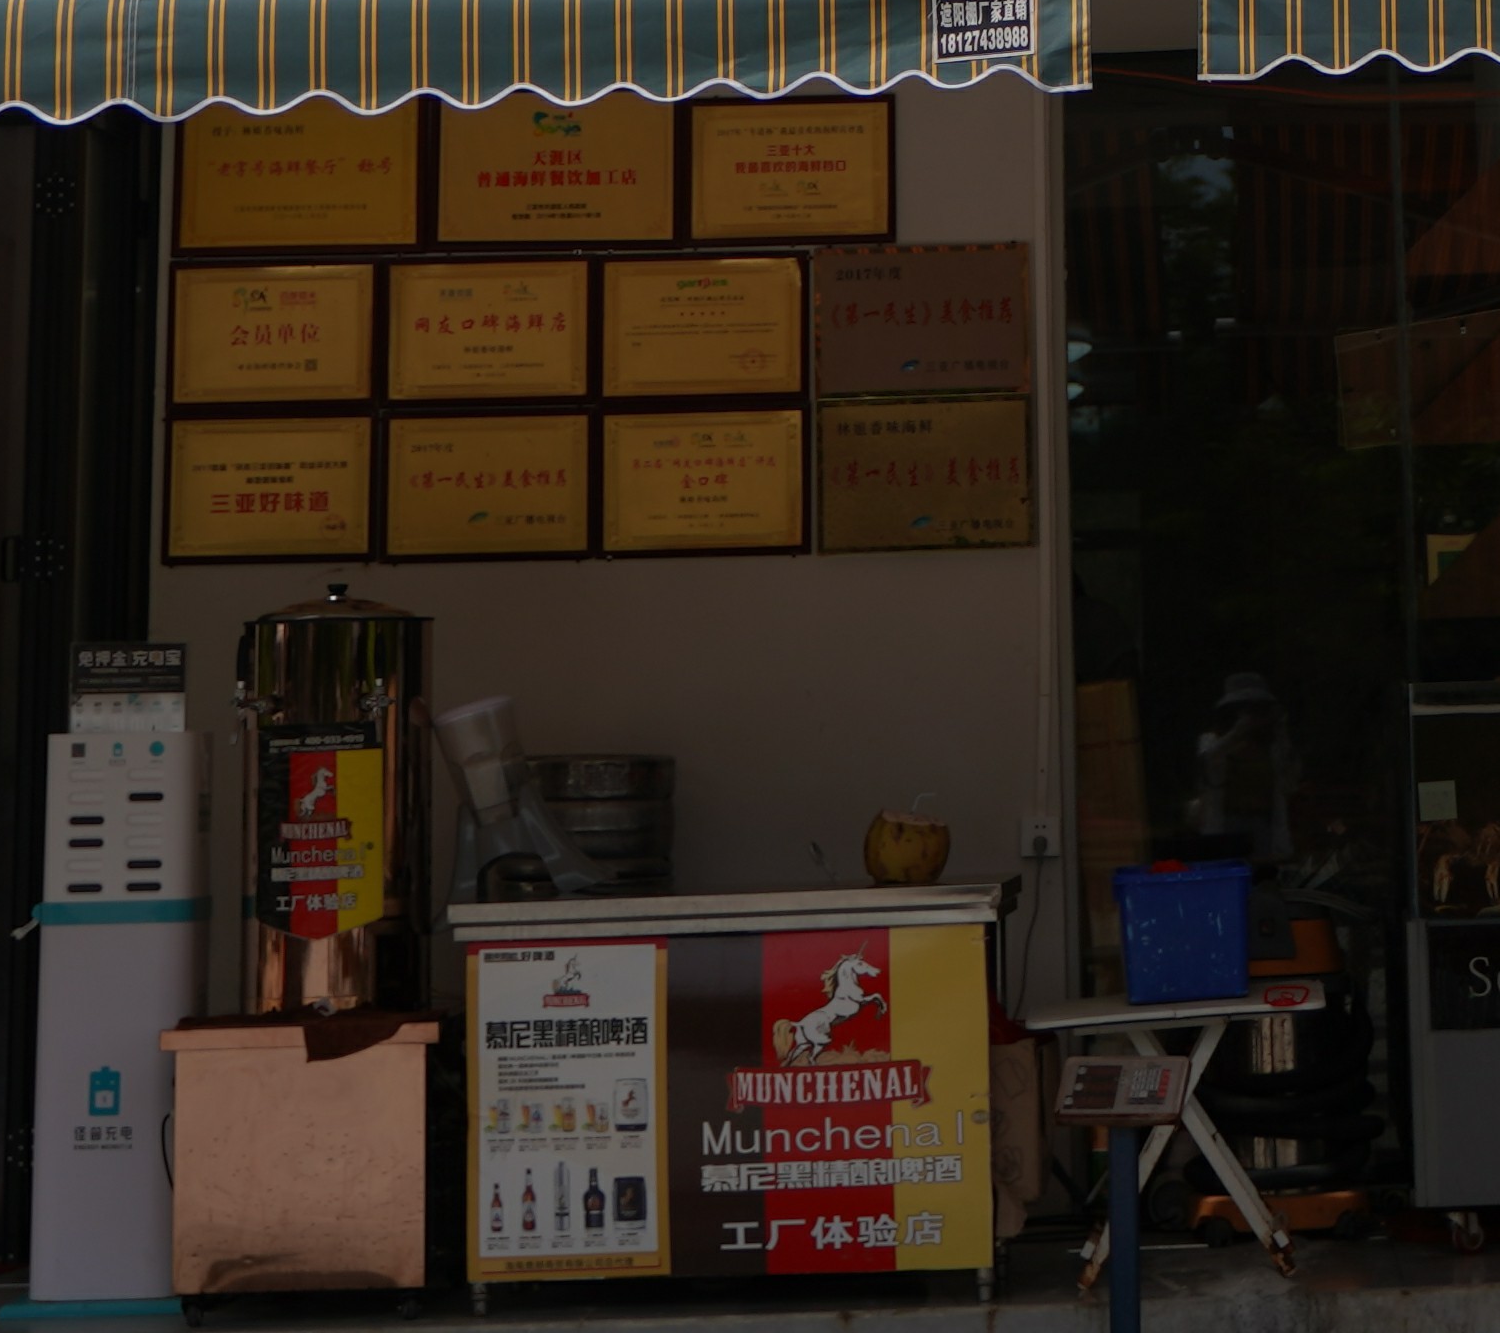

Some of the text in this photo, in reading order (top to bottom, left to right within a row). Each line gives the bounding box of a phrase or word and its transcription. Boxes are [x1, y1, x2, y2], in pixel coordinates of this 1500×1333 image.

[941, 25, 1029, 54] 18127438988
[533, 149, 583, 166] 天涯区
[766, 144, 816, 157] 三亚十大
[230, 323, 320, 346] 会员单位
[414, 312, 567, 335] 网友口碑海鲜店
[210, 491, 330, 514] 三亚好味道
[485, 1017, 648, 1049] 慕尼黑精酿啤酒
[735, 1064, 920, 1105] MUNCHENAL
[700, 1154, 963, 1192] 慕尼黑精酿啤酒
[719, 1211, 944, 1251] 工厂体验店
